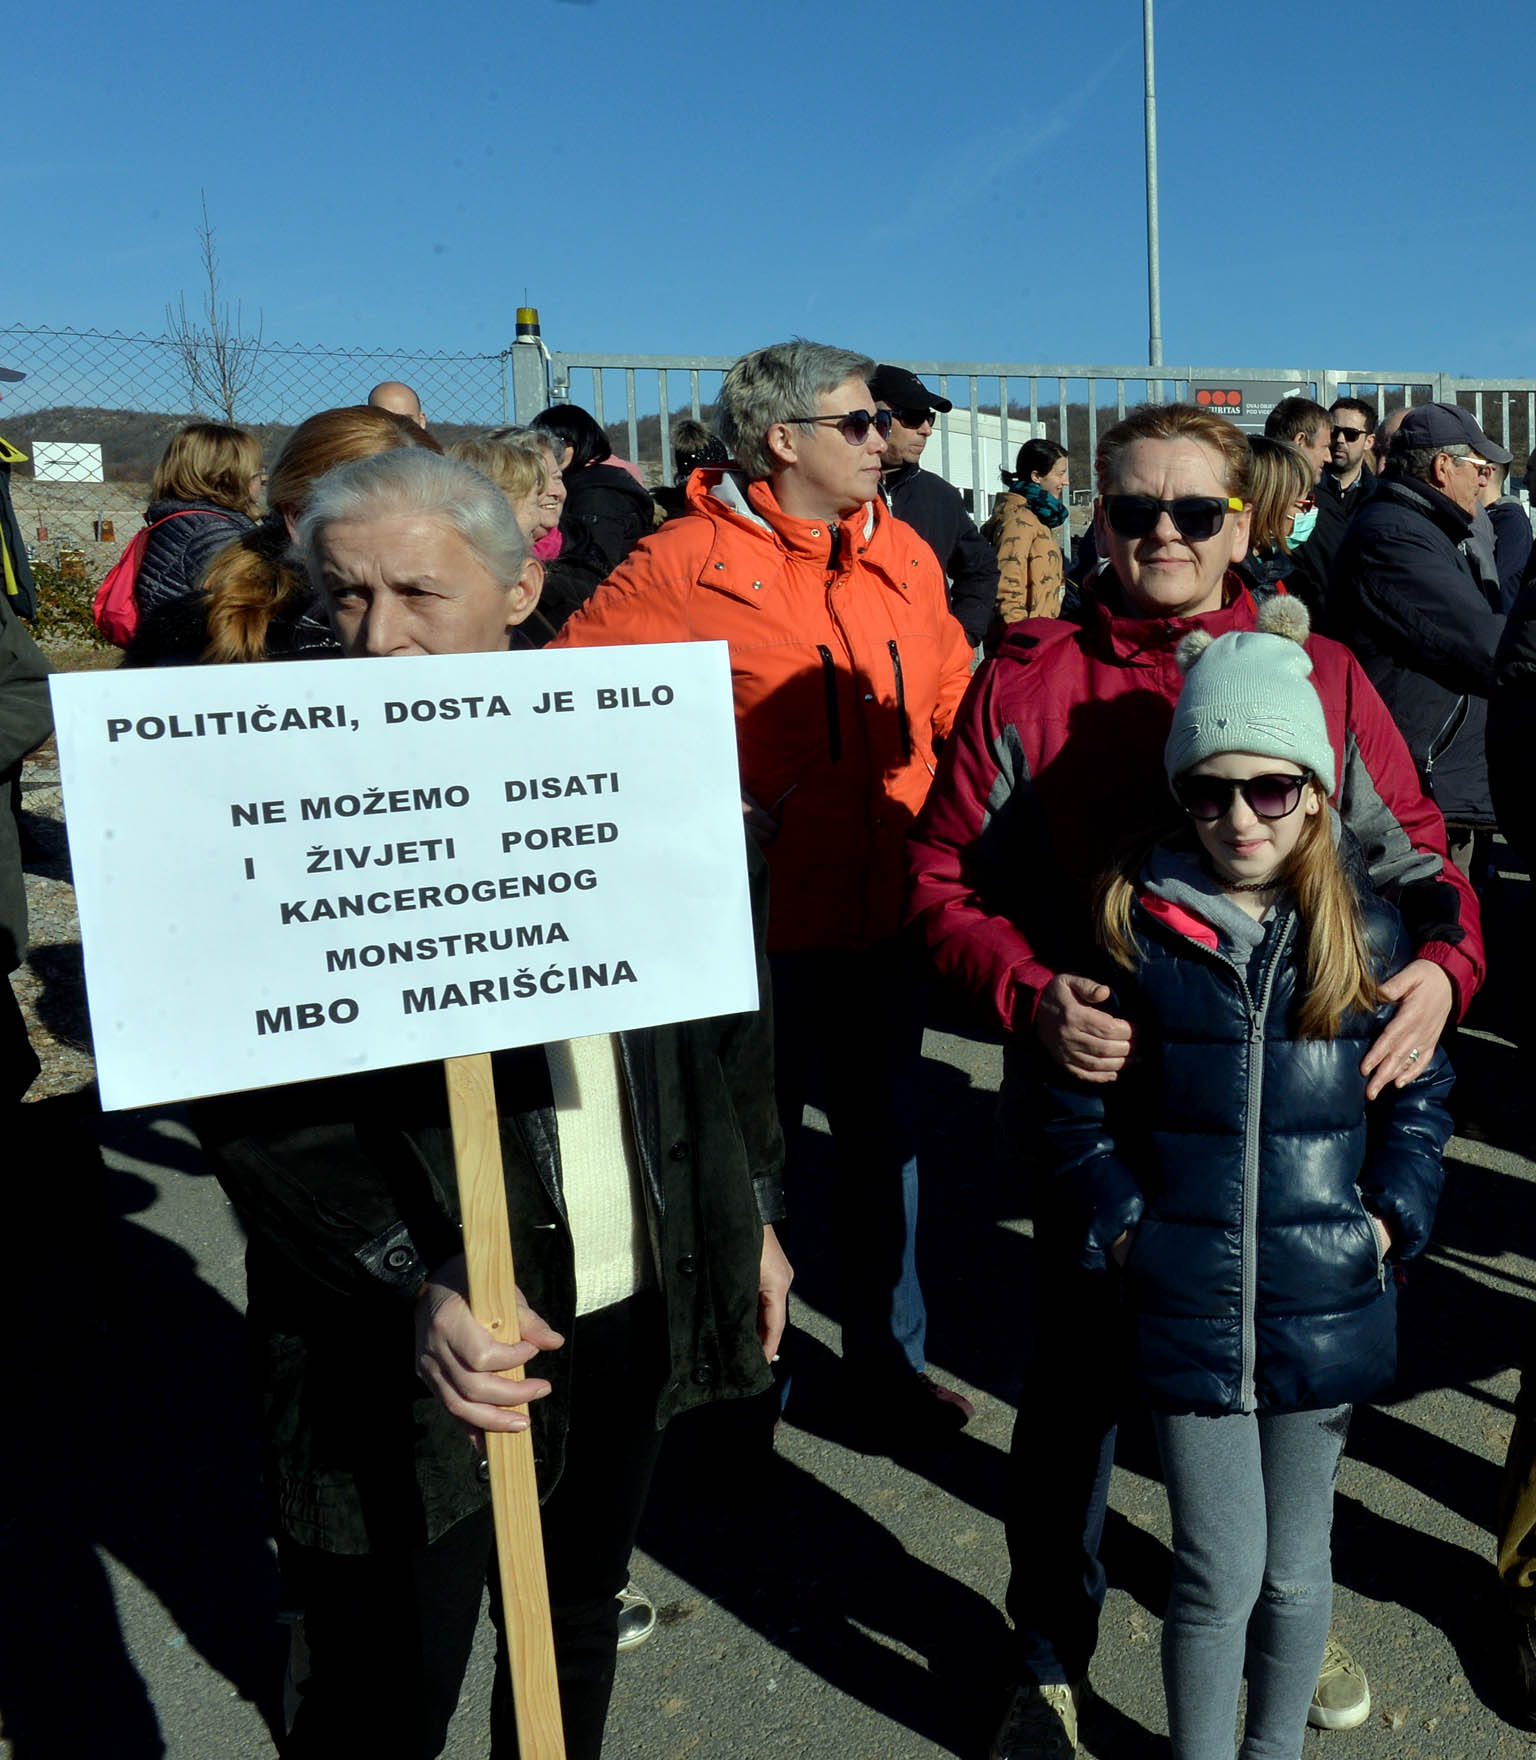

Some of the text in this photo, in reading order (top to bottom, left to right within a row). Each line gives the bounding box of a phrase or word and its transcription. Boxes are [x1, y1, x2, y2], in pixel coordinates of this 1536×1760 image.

[1207, 405, 1241, 415] URITAS
[107, 685, 674, 742] POLITIČARI, DOSTA JE BILO
[231, 772, 619, 827] NE MOŽEMO DISATI
[244, 823, 618, 880] I ŽIVJETI PORED
[280, 869, 597, 925] KANCEROGENOG
[326, 923, 569, 973] MONSTRUMA
[256, 960, 638, 1035] MBO MARIŠĆINA
